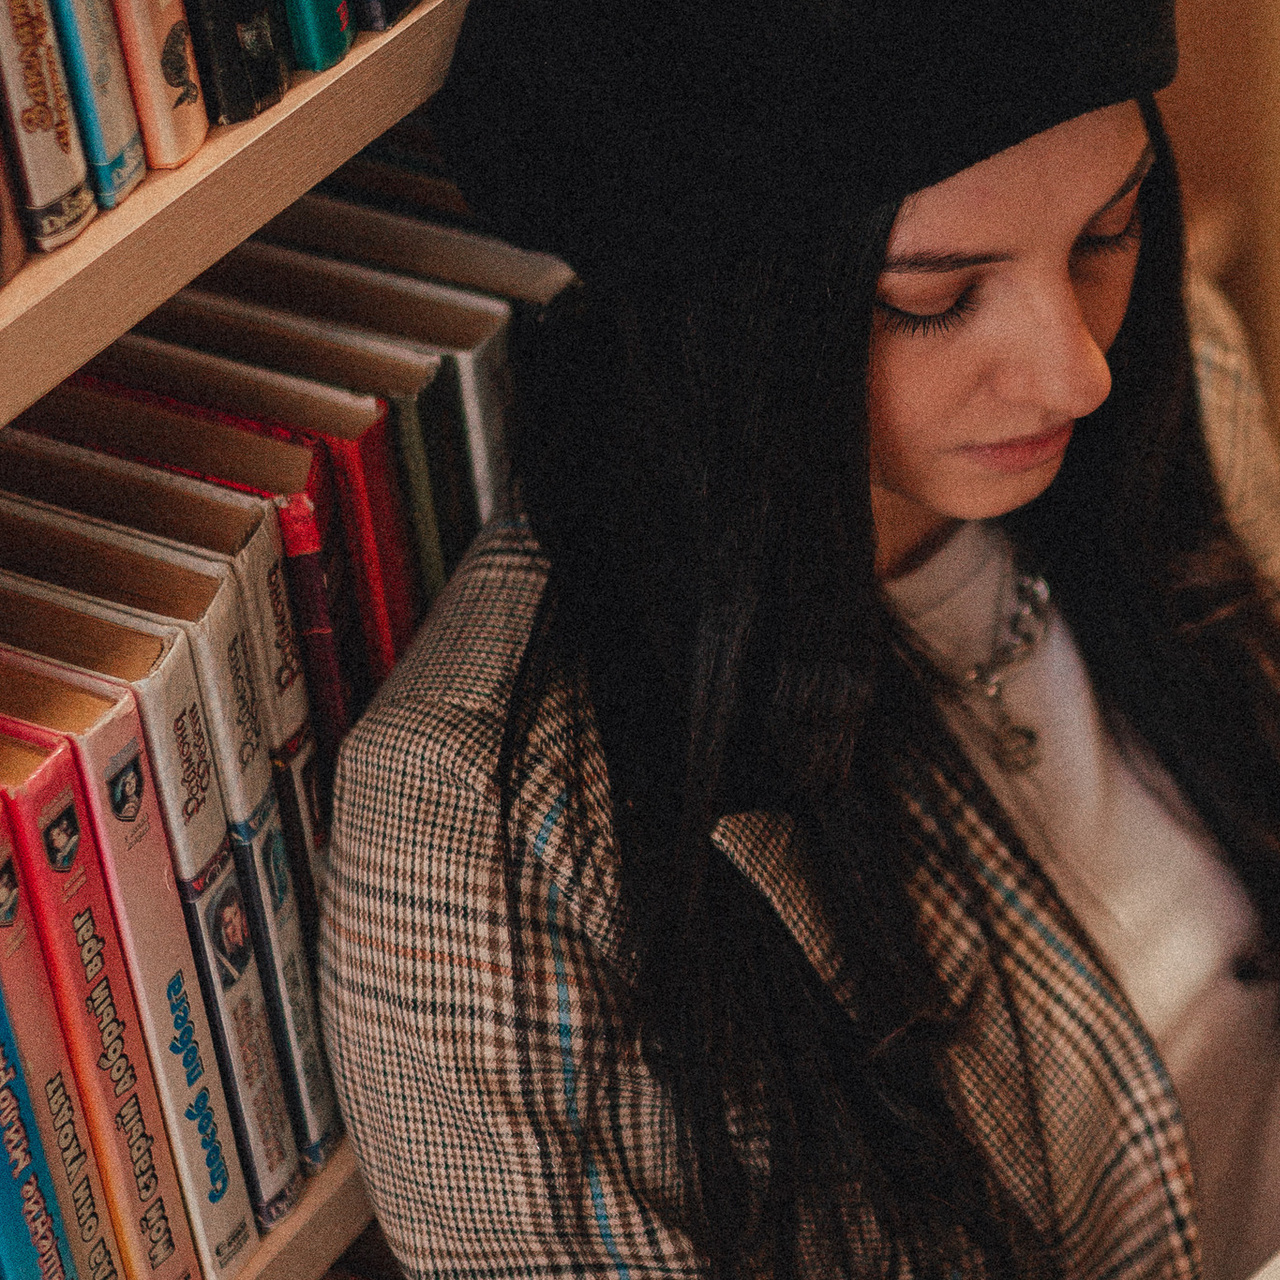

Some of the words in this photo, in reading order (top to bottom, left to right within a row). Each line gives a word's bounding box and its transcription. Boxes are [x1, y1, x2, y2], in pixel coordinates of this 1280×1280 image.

[70, 906, 104, 981] враг
[86, 975, 136, 1097] добрый
[165, 969, 204, 1087] побега
[43, 1071, 87, 1182] уходят
[114, 1092, 159, 1202] старый
[184, 1086, 230, 1204] Способ
[69, 1175, 100, 1244] они
[137, 1196, 175, 1269] Мой
